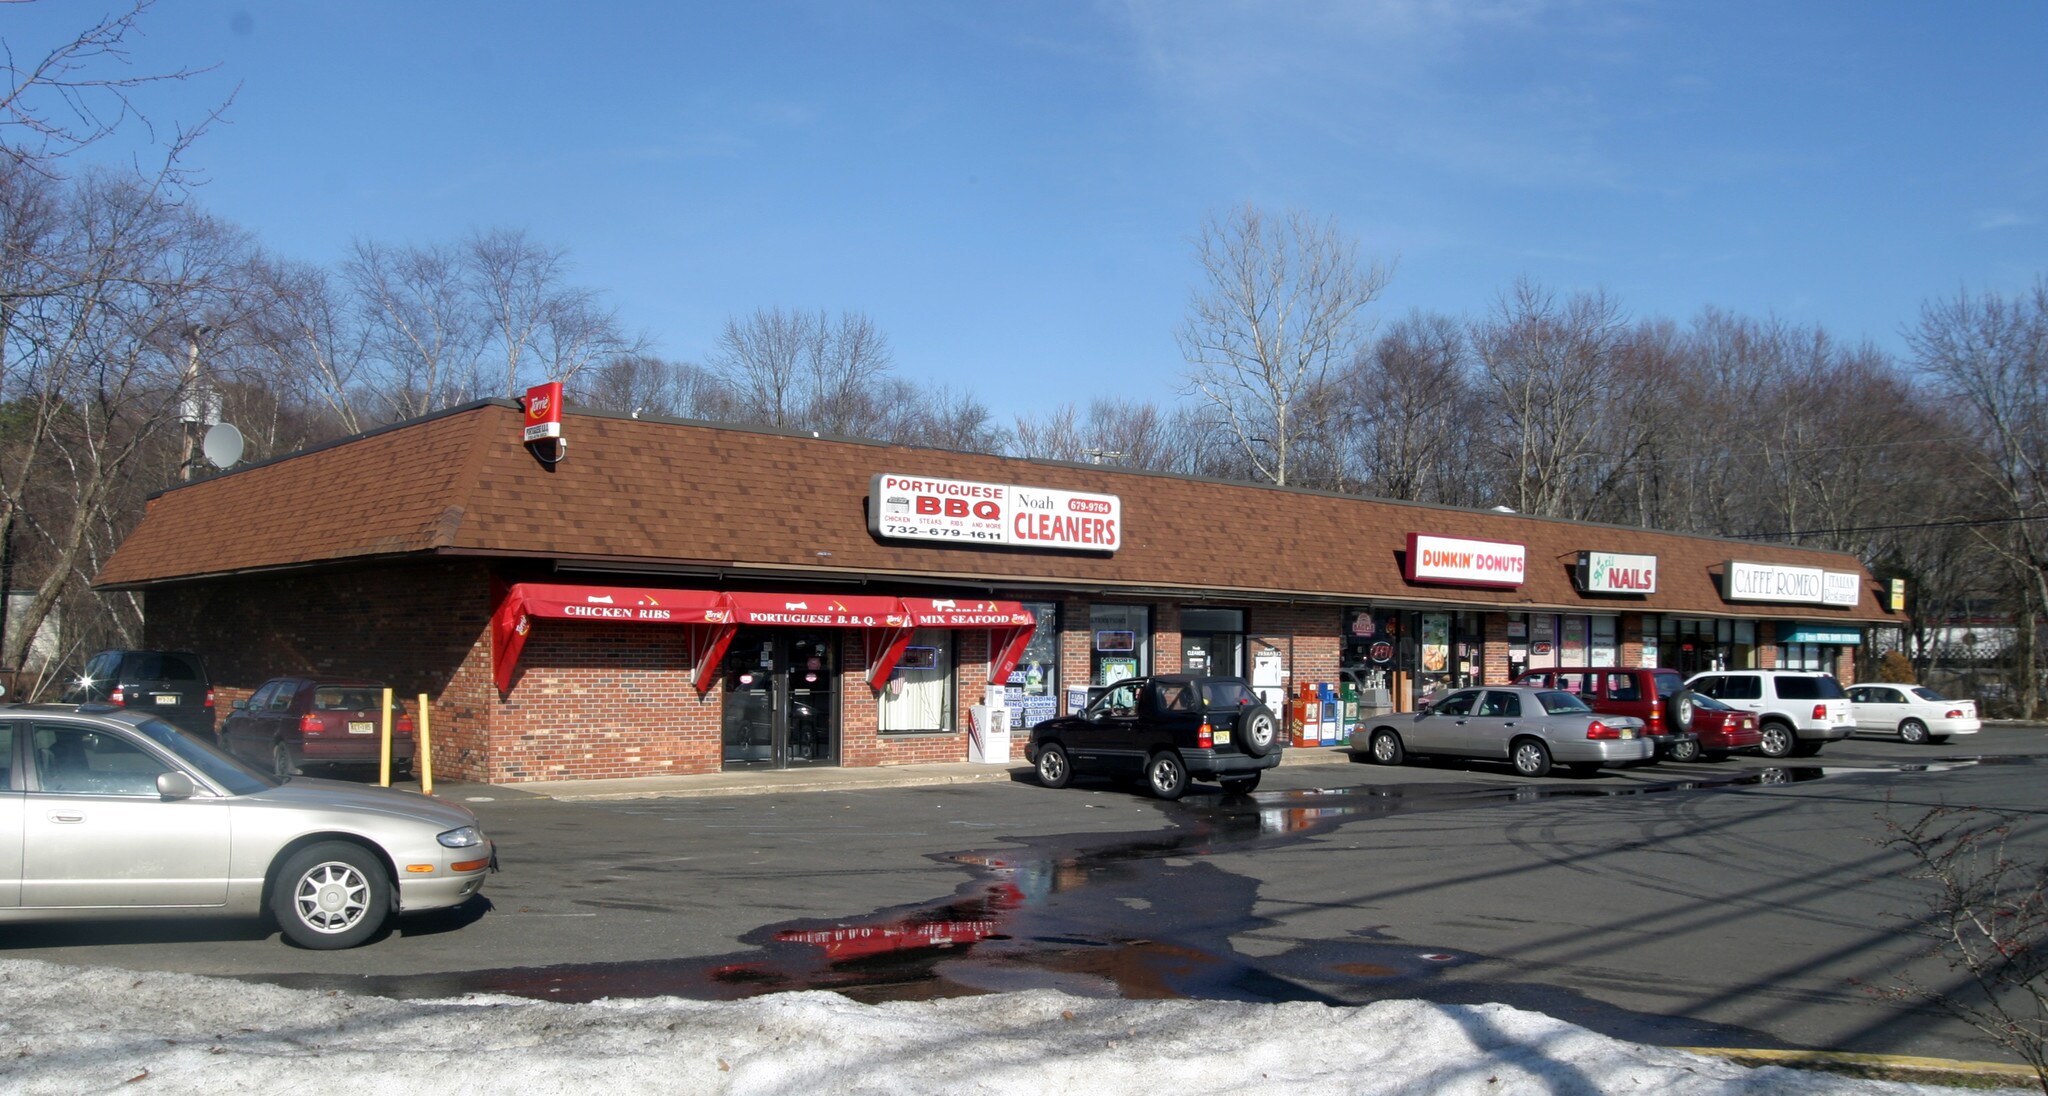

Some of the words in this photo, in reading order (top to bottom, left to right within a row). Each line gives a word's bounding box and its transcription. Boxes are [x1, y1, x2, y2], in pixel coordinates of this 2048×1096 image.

[886, 478, 1003, 499] PORTUGUESE
[915, 495, 1001, 521] BBQ
[1018, 493, 1054, 510] Noah
[1070, 500, 1109, 513] 679-9764
[884, 515, 911, 523] CHICKEN
[919, 517, 942, 525] STEAKS
[1014, 512, 1116, 545] CLEANERS
[886, 524, 1001, 540] 732-679-1611
[1423, 549, 1474, 569] DUNKIN'
[1476, 554, 1523, 573] DONUTS
[1608, 567, 1652, 590] NAILS
[1776, 572, 1820, 597] ROMEO
[564, 605, 632, 618] CHICKEN
[639, 609, 671, 619] RIBS
[750, 612, 832, 624] PORTUGUESE
[920, 615, 946, 624] MIX
[950, 615, 1010, 624] SEAFOOD
